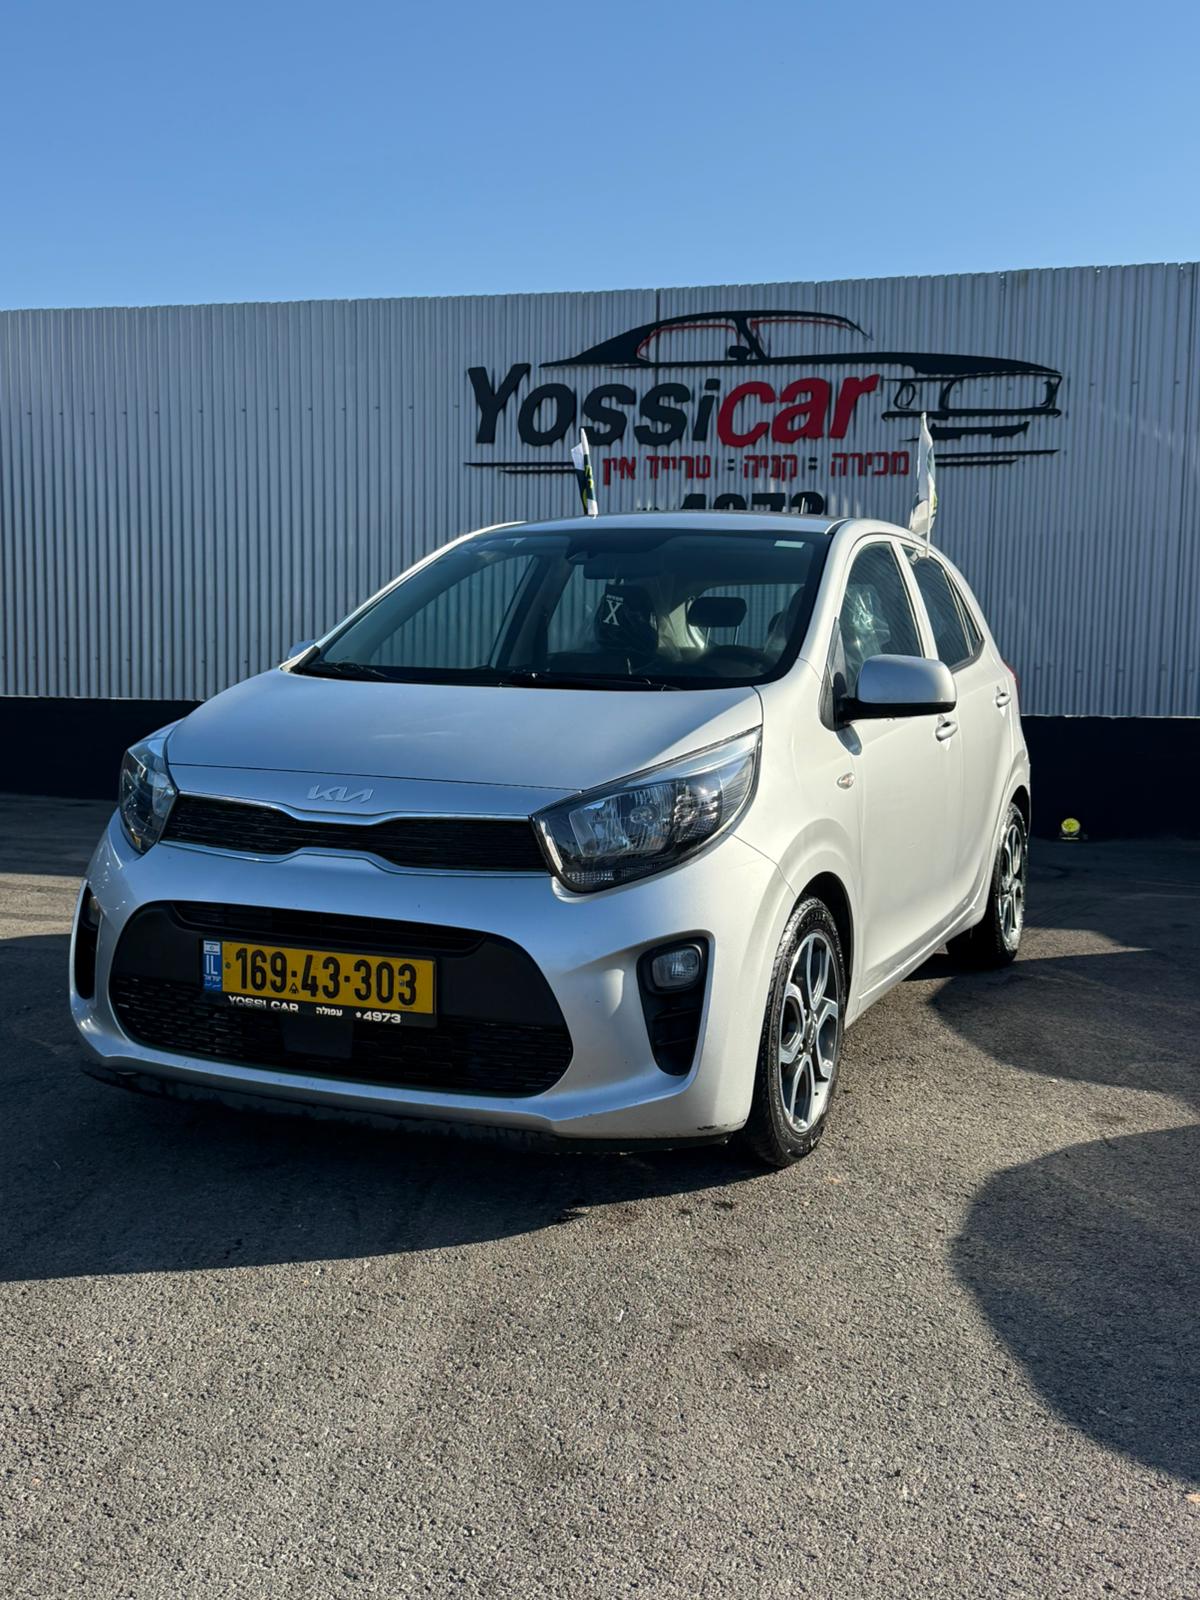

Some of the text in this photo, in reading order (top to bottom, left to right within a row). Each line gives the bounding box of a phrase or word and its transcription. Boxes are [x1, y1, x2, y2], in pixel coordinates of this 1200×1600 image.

[468, 363, 880, 447] Yossicar
[602, 451, 909, 486] מכירה קניה טרייד אין
[206, 954, 219, 975] IL
[228, 995, 299, 1013] YOSSI CAR
